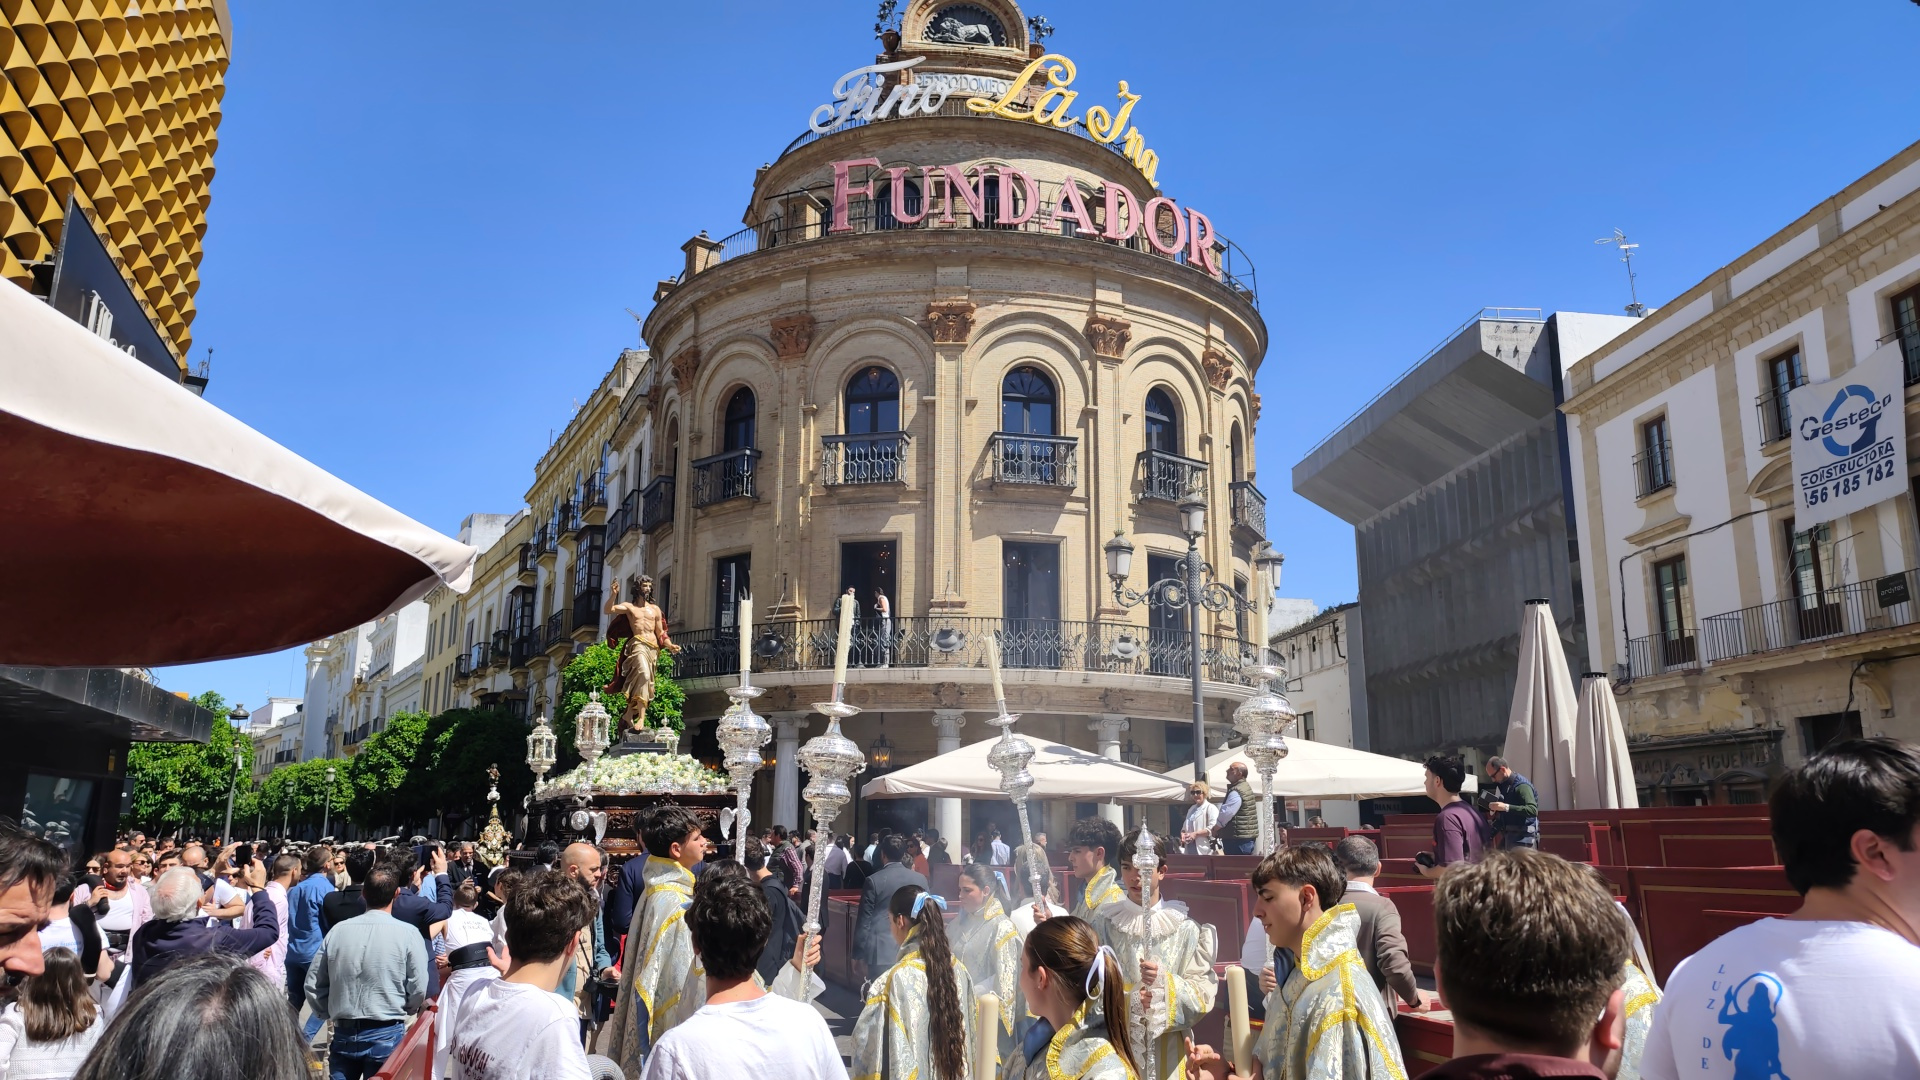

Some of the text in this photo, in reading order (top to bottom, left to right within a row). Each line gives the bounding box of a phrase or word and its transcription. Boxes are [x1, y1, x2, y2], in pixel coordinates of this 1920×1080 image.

[809, 55, 959, 134] Fino
[966, 54, 1080, 128] La
[829, 157, 1220, 277] FUNDADOR
[1800, 394, 1892, 441] Gesteco
[1801, 441, 1894, 486] CONSTRUCTORA
[1804, 487, 1829, 508] 56
[1833, 474, 1861, 498] 185
